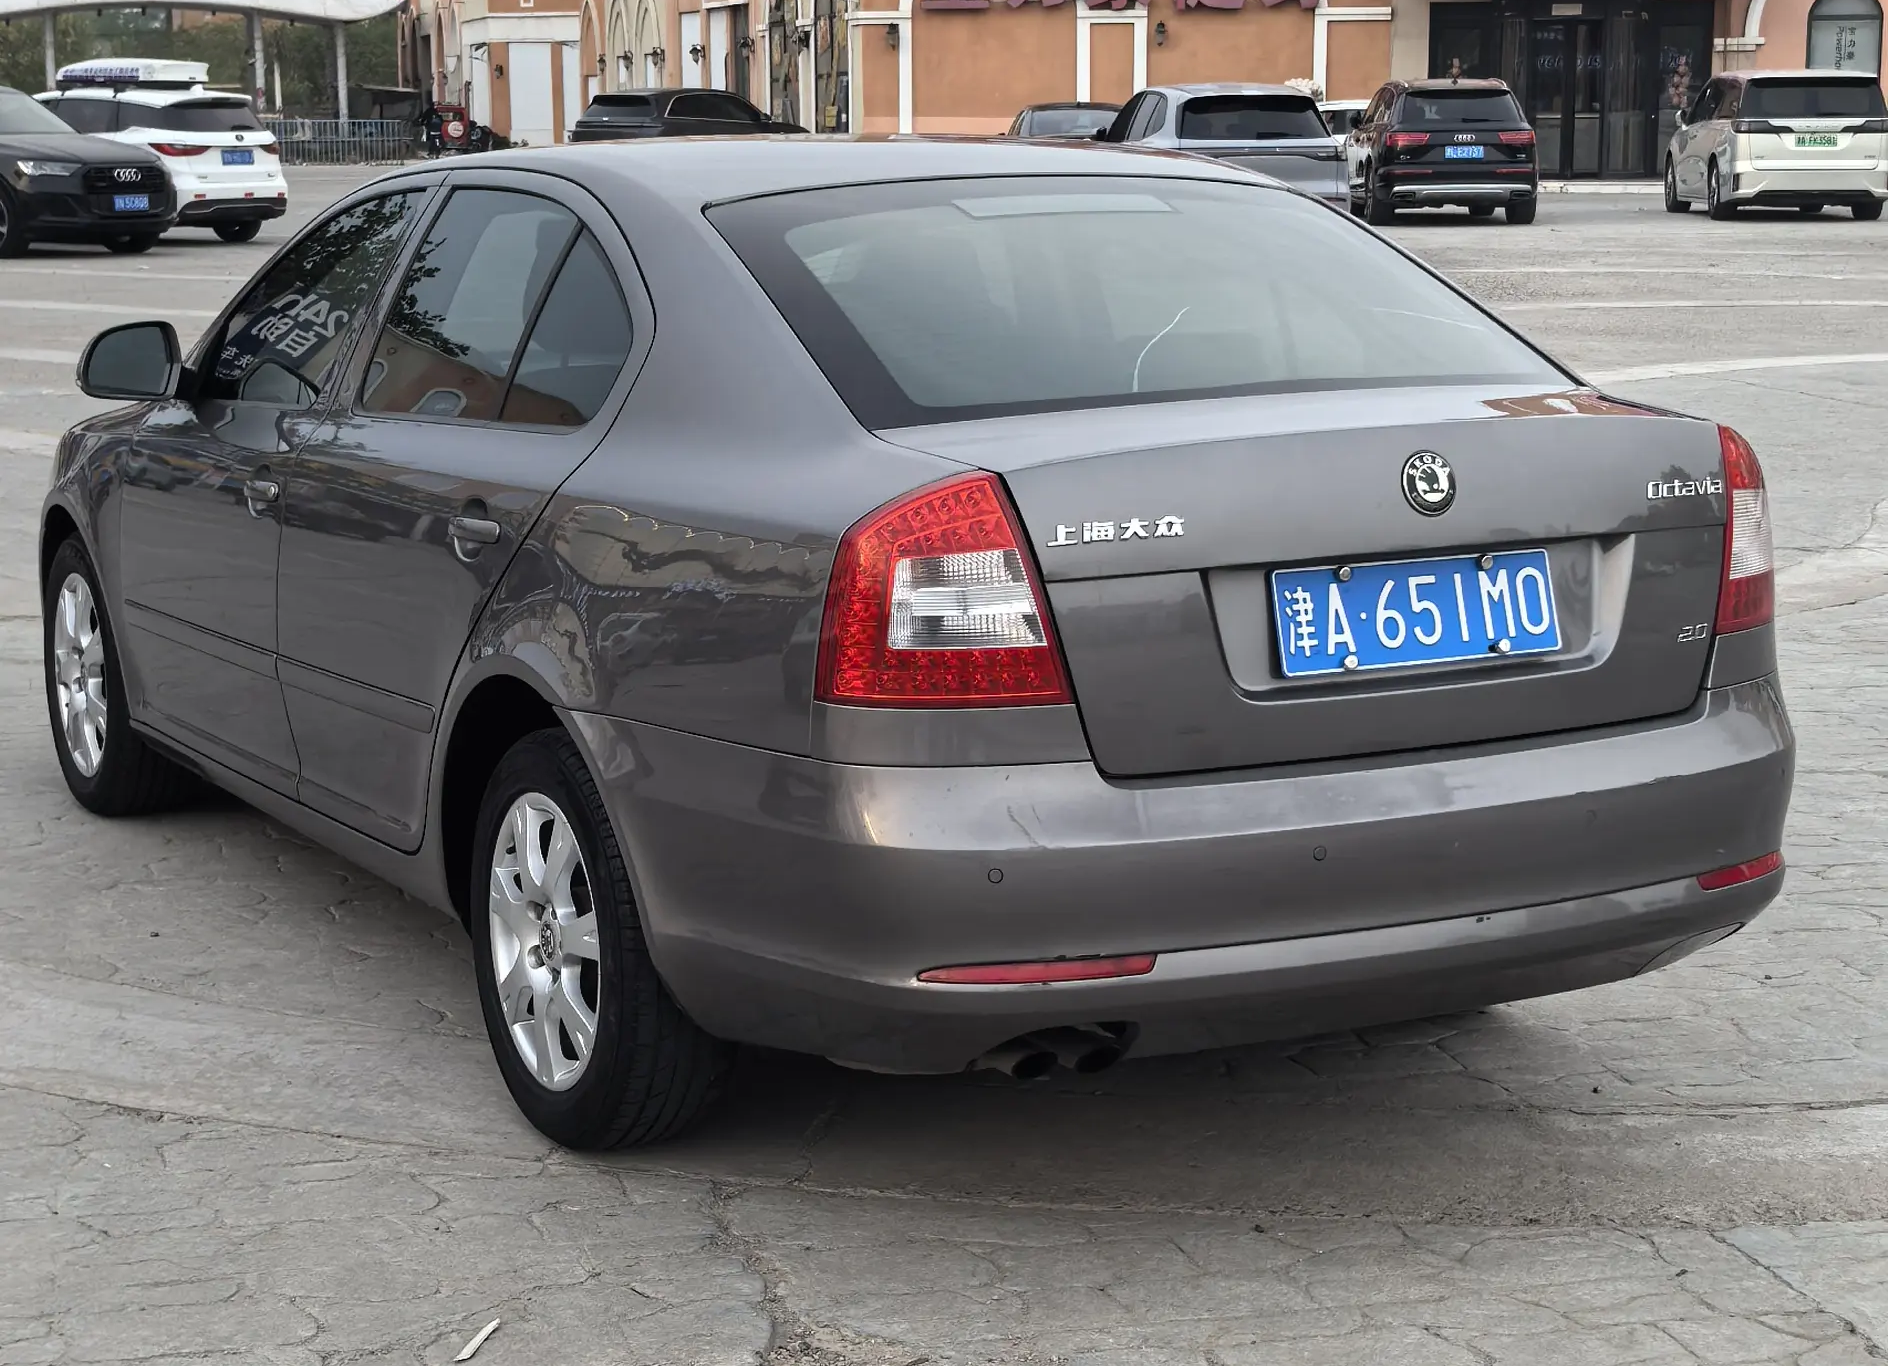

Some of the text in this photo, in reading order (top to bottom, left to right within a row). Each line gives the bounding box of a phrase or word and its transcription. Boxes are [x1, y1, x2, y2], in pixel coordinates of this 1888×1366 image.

[1646, 476, 1723, 499] Octavia
[1046, 514, 1185, 547] 上海大众
